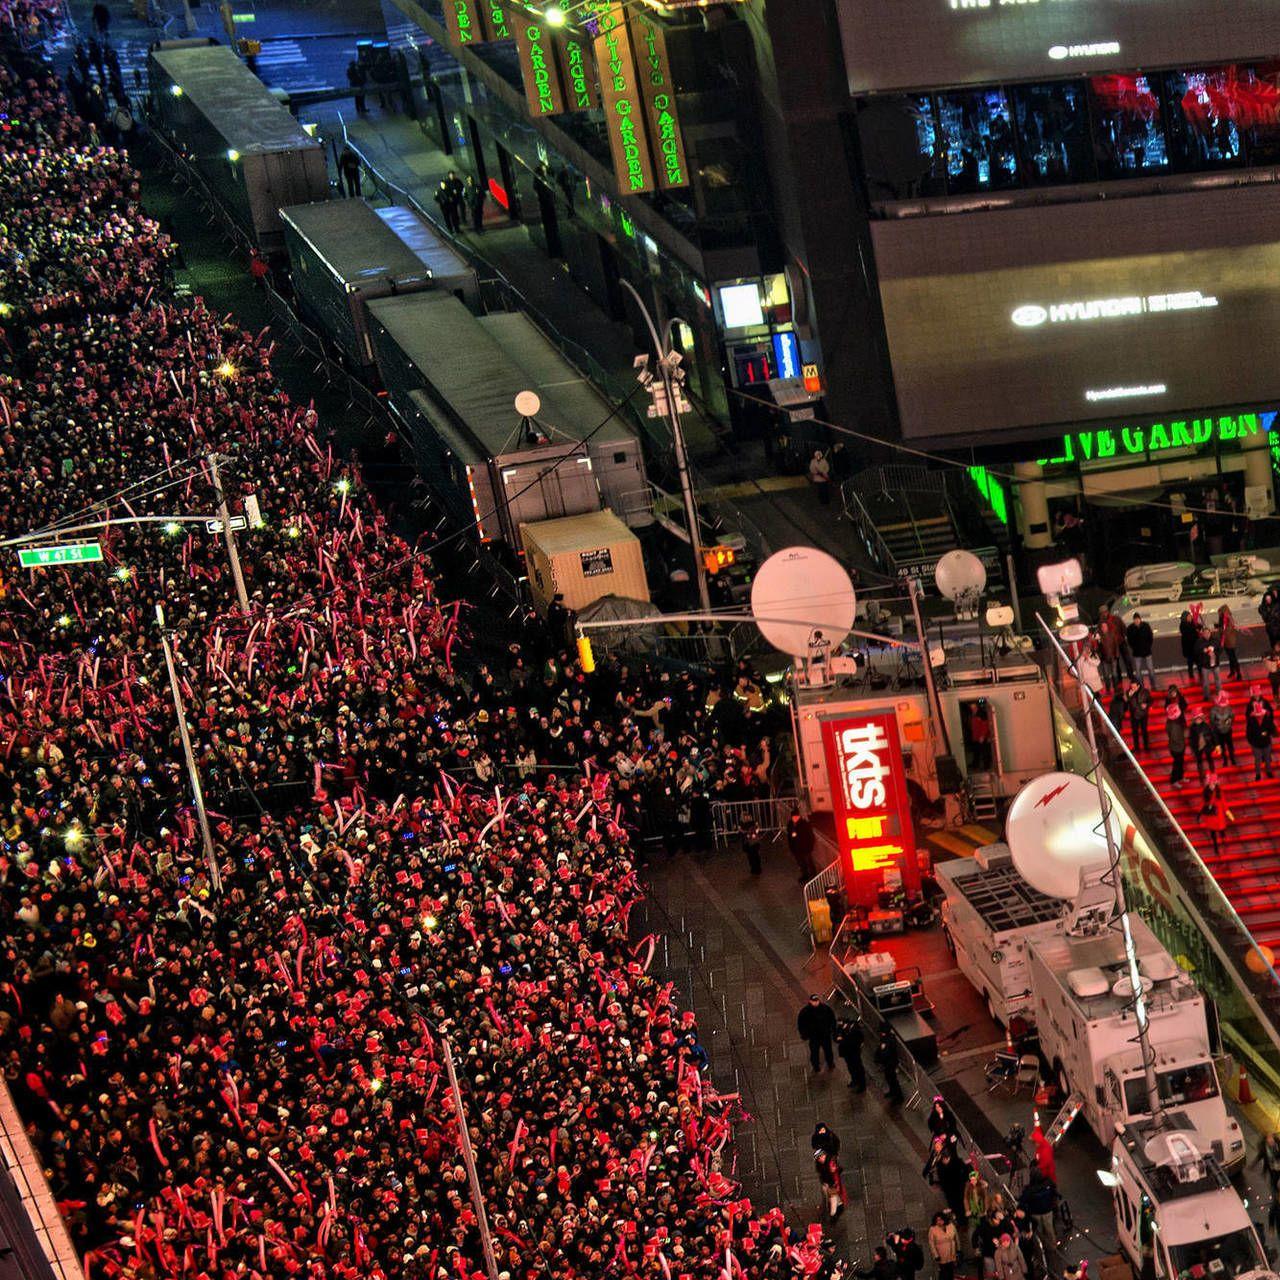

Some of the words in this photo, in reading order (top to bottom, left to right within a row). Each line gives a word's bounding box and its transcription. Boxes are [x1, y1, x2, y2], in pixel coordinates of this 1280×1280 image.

[526, 25, 554, 113] GARDEN
[1069, 41, 1120, 58] HYUNDAI
[601, 14, 627, 92] OLIVE
[615, 99, 644, 190] GARDEN
[1050, 296, 1142, 322] HYUNDAI
[39, 552, 49, 562] W
[54, 551, 65, 560] 47
[71, 550, 82, 559] St
[841, 722, 891, 810] tkts
